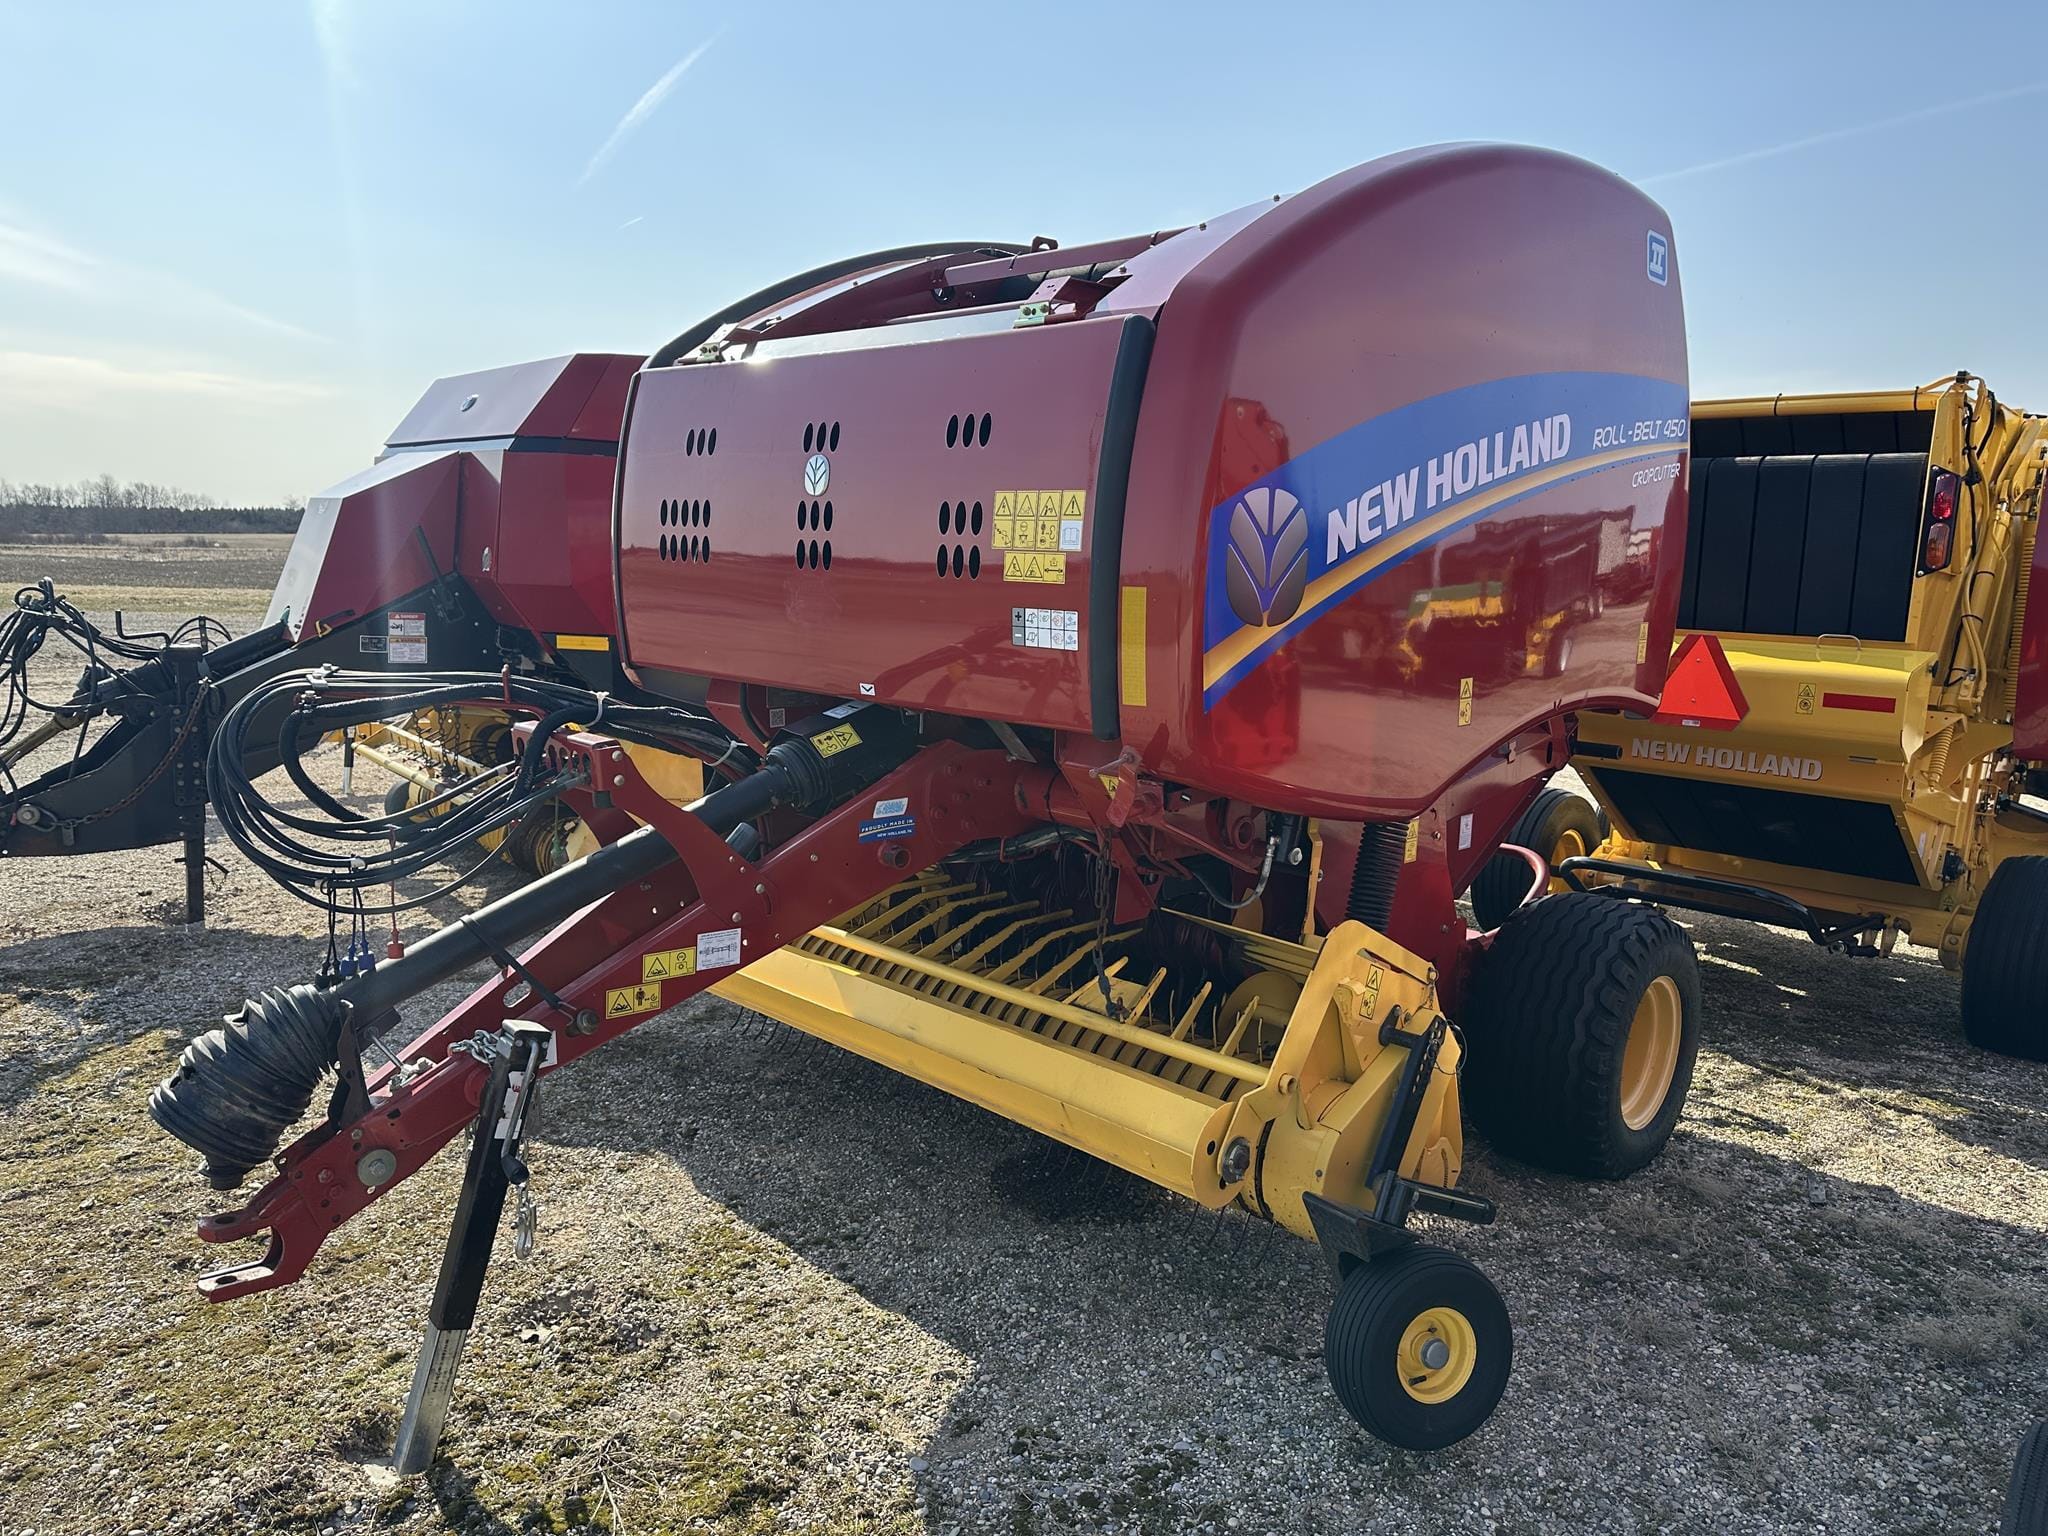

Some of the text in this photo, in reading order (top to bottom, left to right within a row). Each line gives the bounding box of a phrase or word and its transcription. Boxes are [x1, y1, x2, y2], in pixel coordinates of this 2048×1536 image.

[1592, 419, 1686, 450] ROLL-BELT 450
[1326, 413, 1571, 565] NEW HOLLAND
[1632, 463, 1680, 488] CROPCUTTER
[1631, 738, 1823, 781] NEW HOLLAND
[861, 823, 887, 832] PROUDLY
